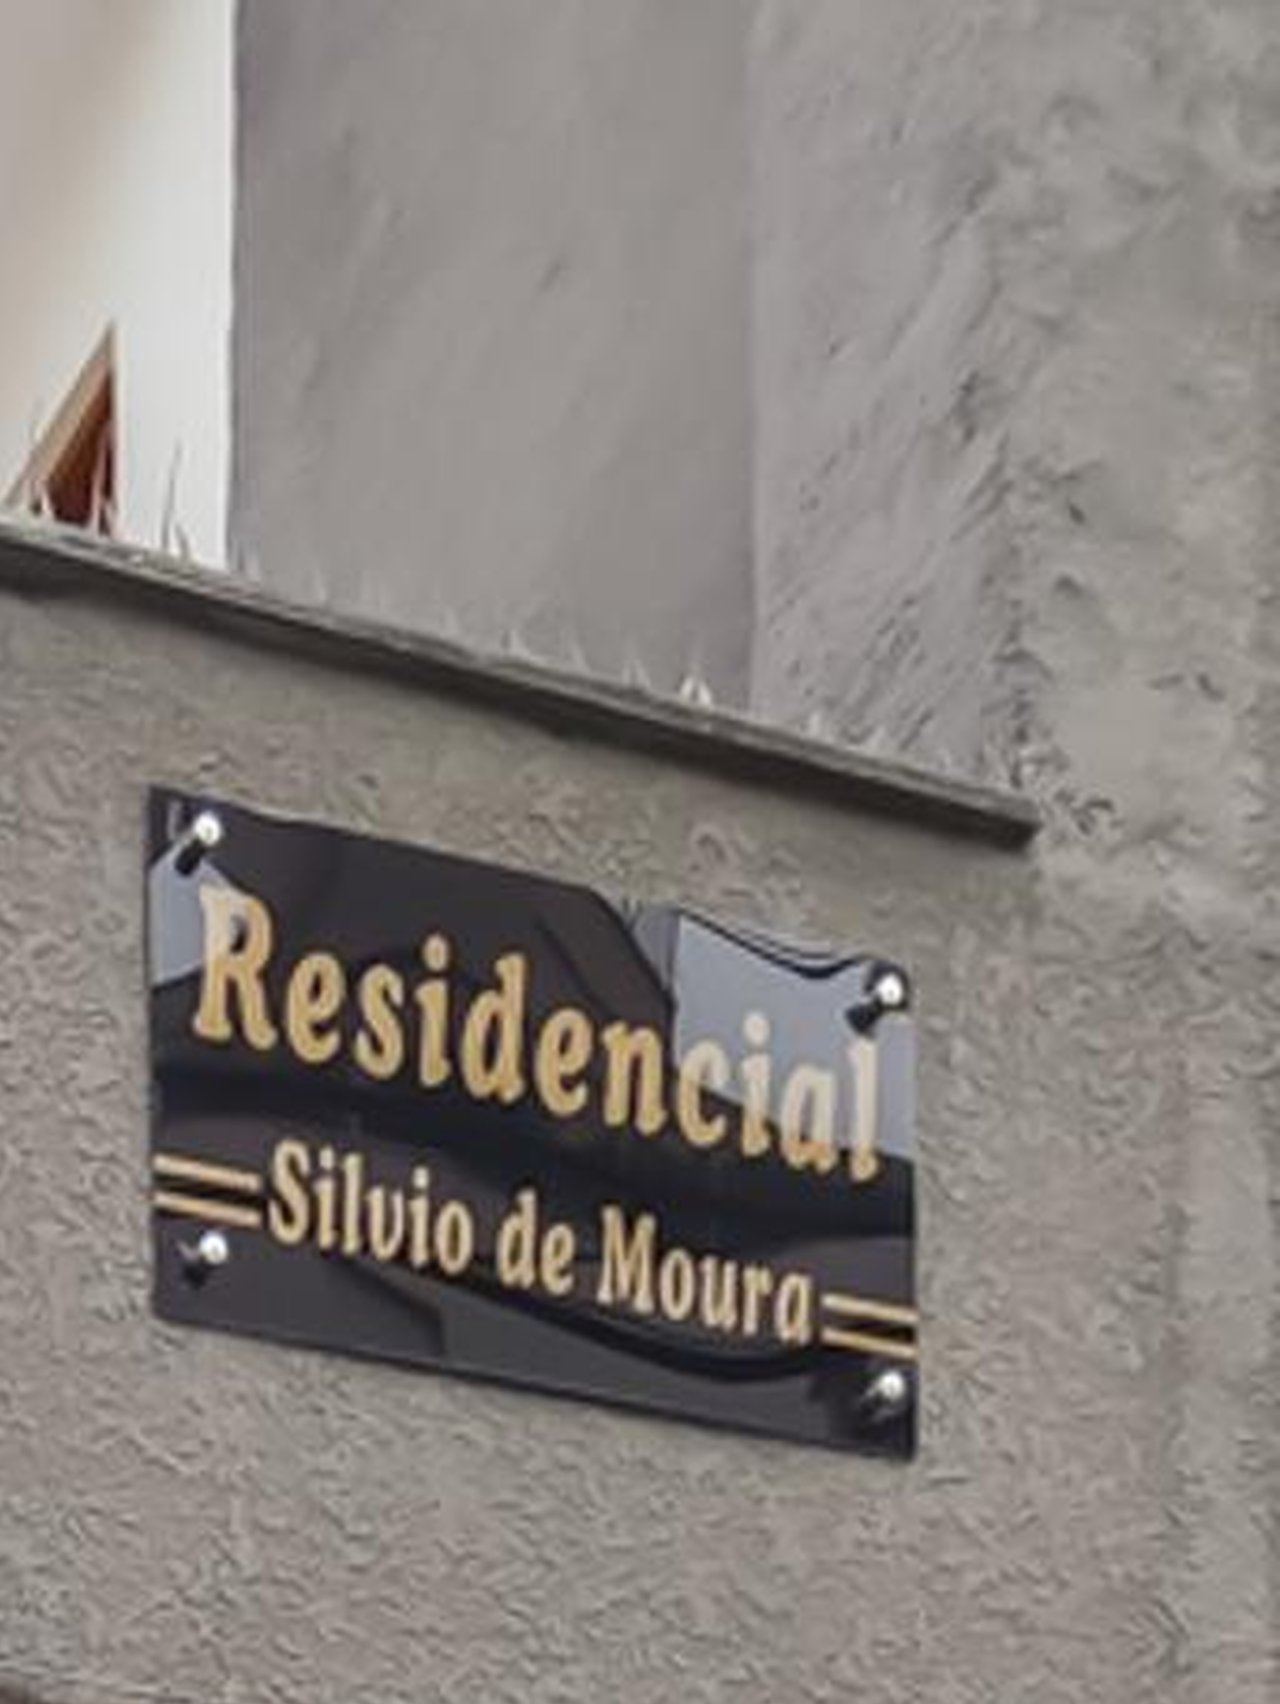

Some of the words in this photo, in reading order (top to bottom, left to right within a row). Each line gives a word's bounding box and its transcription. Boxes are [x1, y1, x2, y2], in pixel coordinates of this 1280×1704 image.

[193, 883, 881, 1182] Residencial
[267, 1139, 474, 1276] Silvio
[496, 1189, 576, 1296] de
[597, 1205, 814, 1346] Moura
